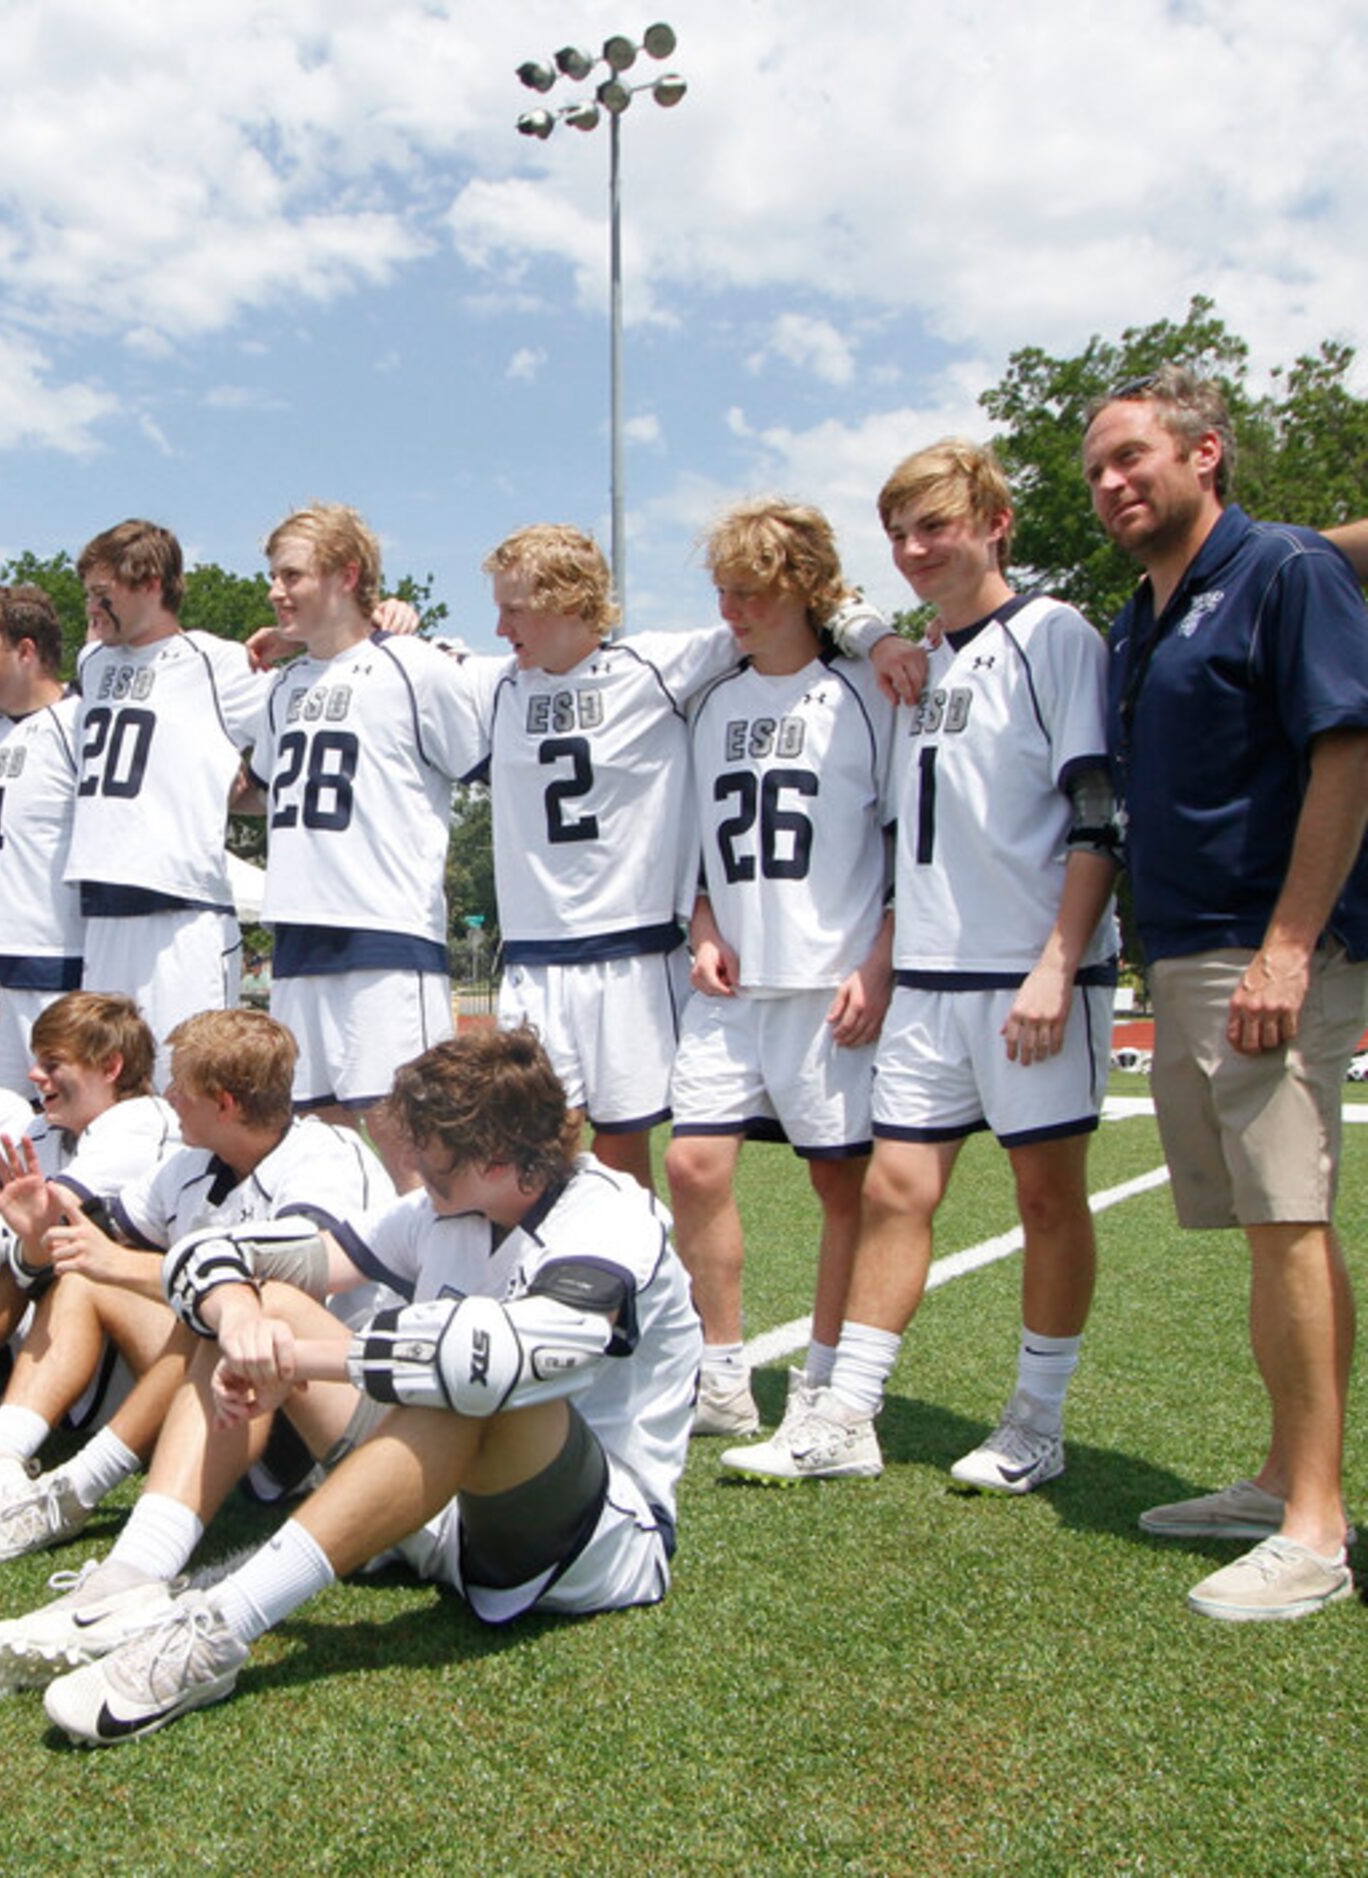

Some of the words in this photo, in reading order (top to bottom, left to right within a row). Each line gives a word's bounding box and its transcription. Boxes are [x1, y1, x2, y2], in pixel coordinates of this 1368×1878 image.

[98, 665, 156, 700] ESD
[287, 685, 353, 723] ESD
[526, 688, 603, 734] ESD
[78, 707, 157, 799] 20
[726, 716, 805, 762] ESD
[271, 730, 359, 831] 28
[538, 737, 599, 843] 2
[916, 746, 938, 865] 1
[713, 769, 819, 884] 26
[470, 1327, 490, 1388] STX
